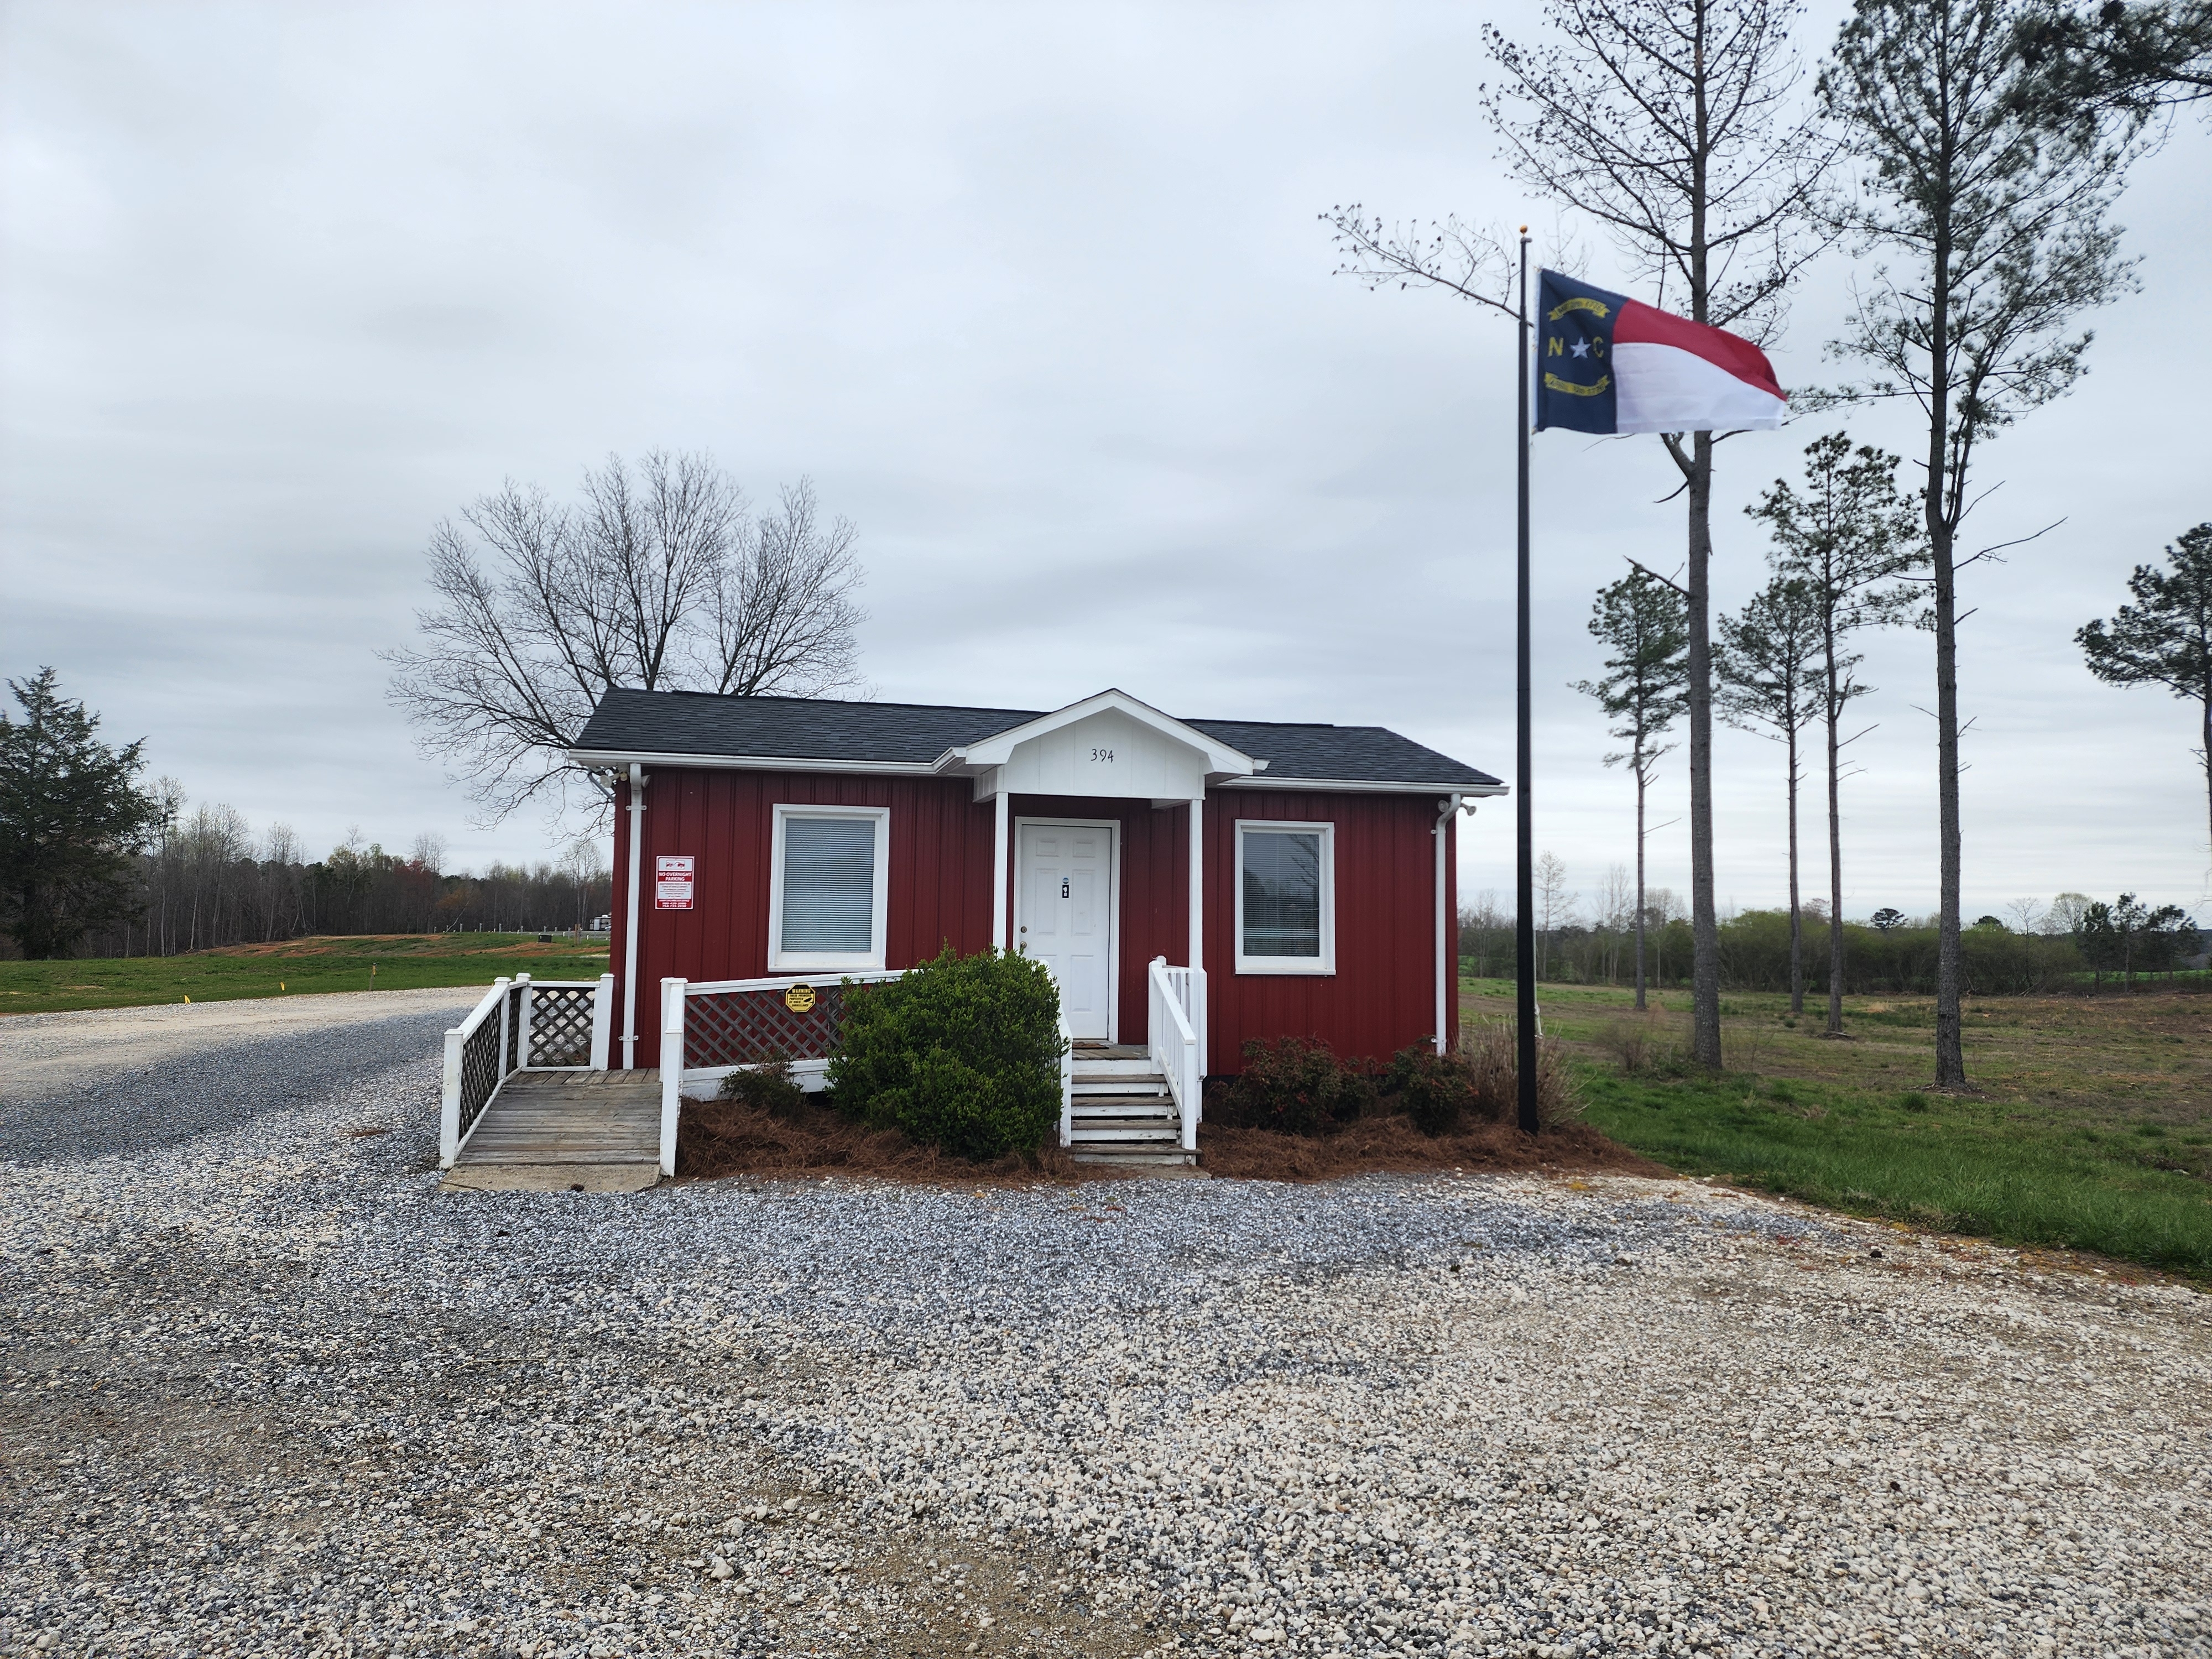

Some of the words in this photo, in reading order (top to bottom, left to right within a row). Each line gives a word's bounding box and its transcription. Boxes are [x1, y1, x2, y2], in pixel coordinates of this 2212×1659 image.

[1548, 336, 1564, 357] N
[1592, 336, 1604, 358] C
[1091, 748, 1114, 763] 394
